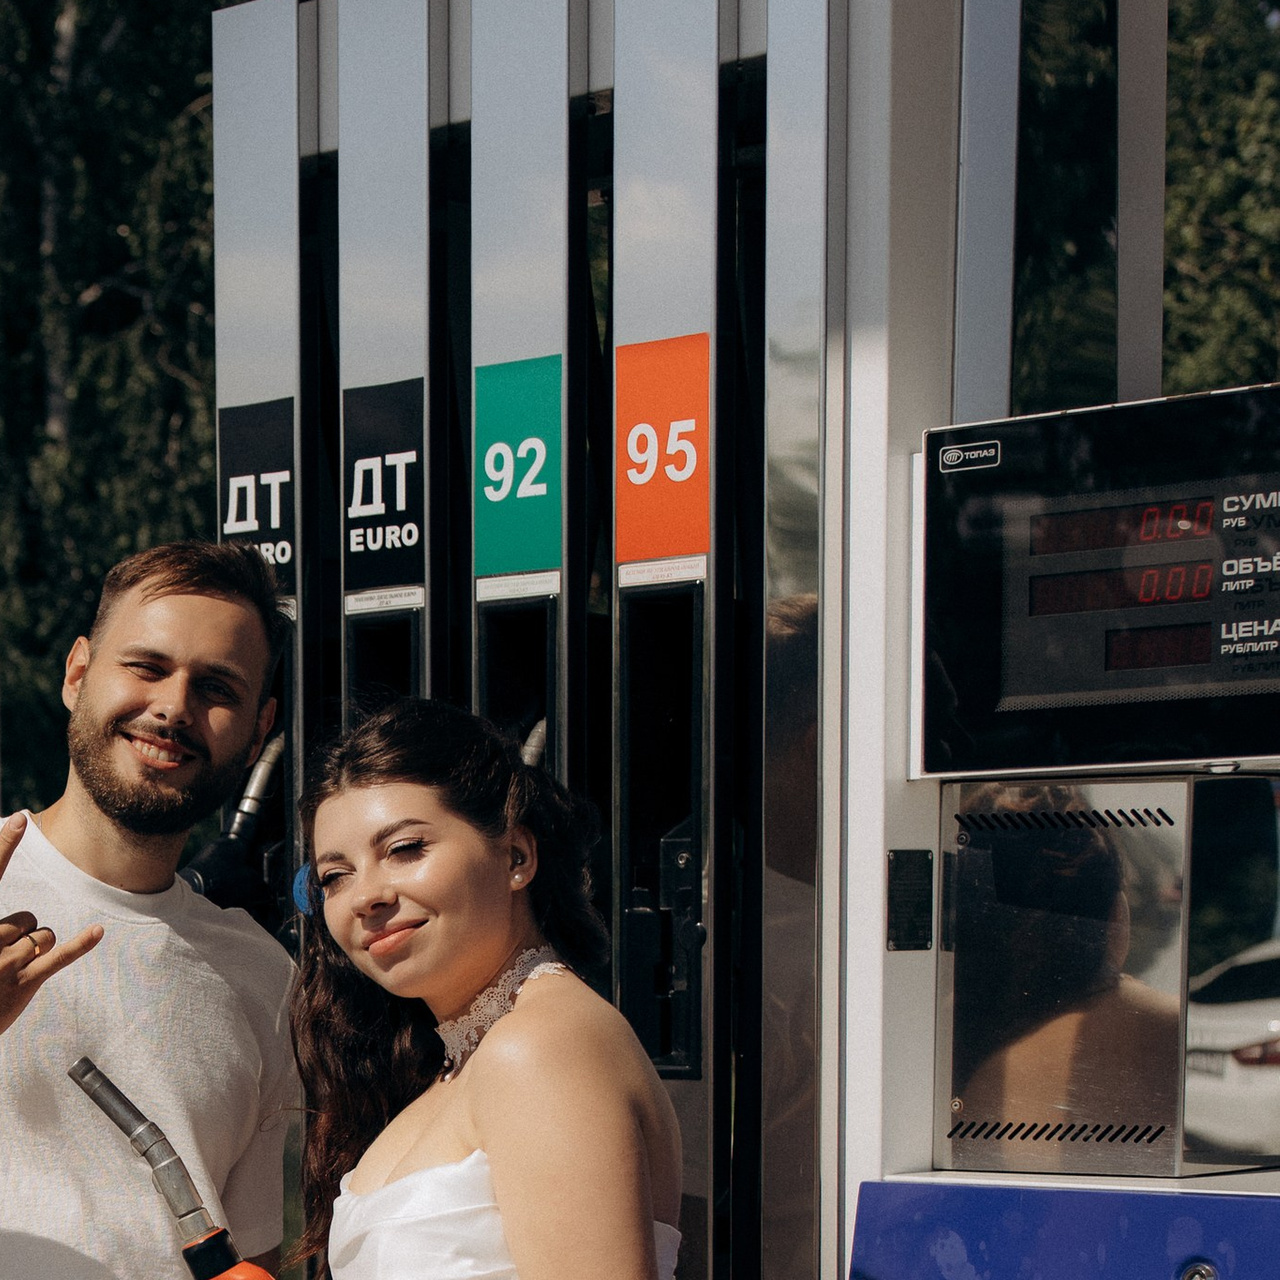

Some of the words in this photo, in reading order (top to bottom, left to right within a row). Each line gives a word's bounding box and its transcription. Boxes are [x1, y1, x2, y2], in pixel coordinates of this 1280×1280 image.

[627, 418, 697, 485] 95
[964, 448, 996, 460] ТОПАЗ
[484, 437, 547, 502] 92
[347, 450, 417, 518] ДТ
[223, 470, 290, 534] ДТ
[1223, 491, 1280, 513] СУМ
[1222, 516, 1247, 529] РУБ
[350, 522, 419, 552] EURO
[253, 540, 292, 565] RO
[1138, 564, 1213, 603] 0.00
[1221, 579, 1254, 592] ЛИТР
[1221, 618, 1280, 641] ЦЕНА
[1220, 640, 1278, 655] РУБ/ЛИТР
